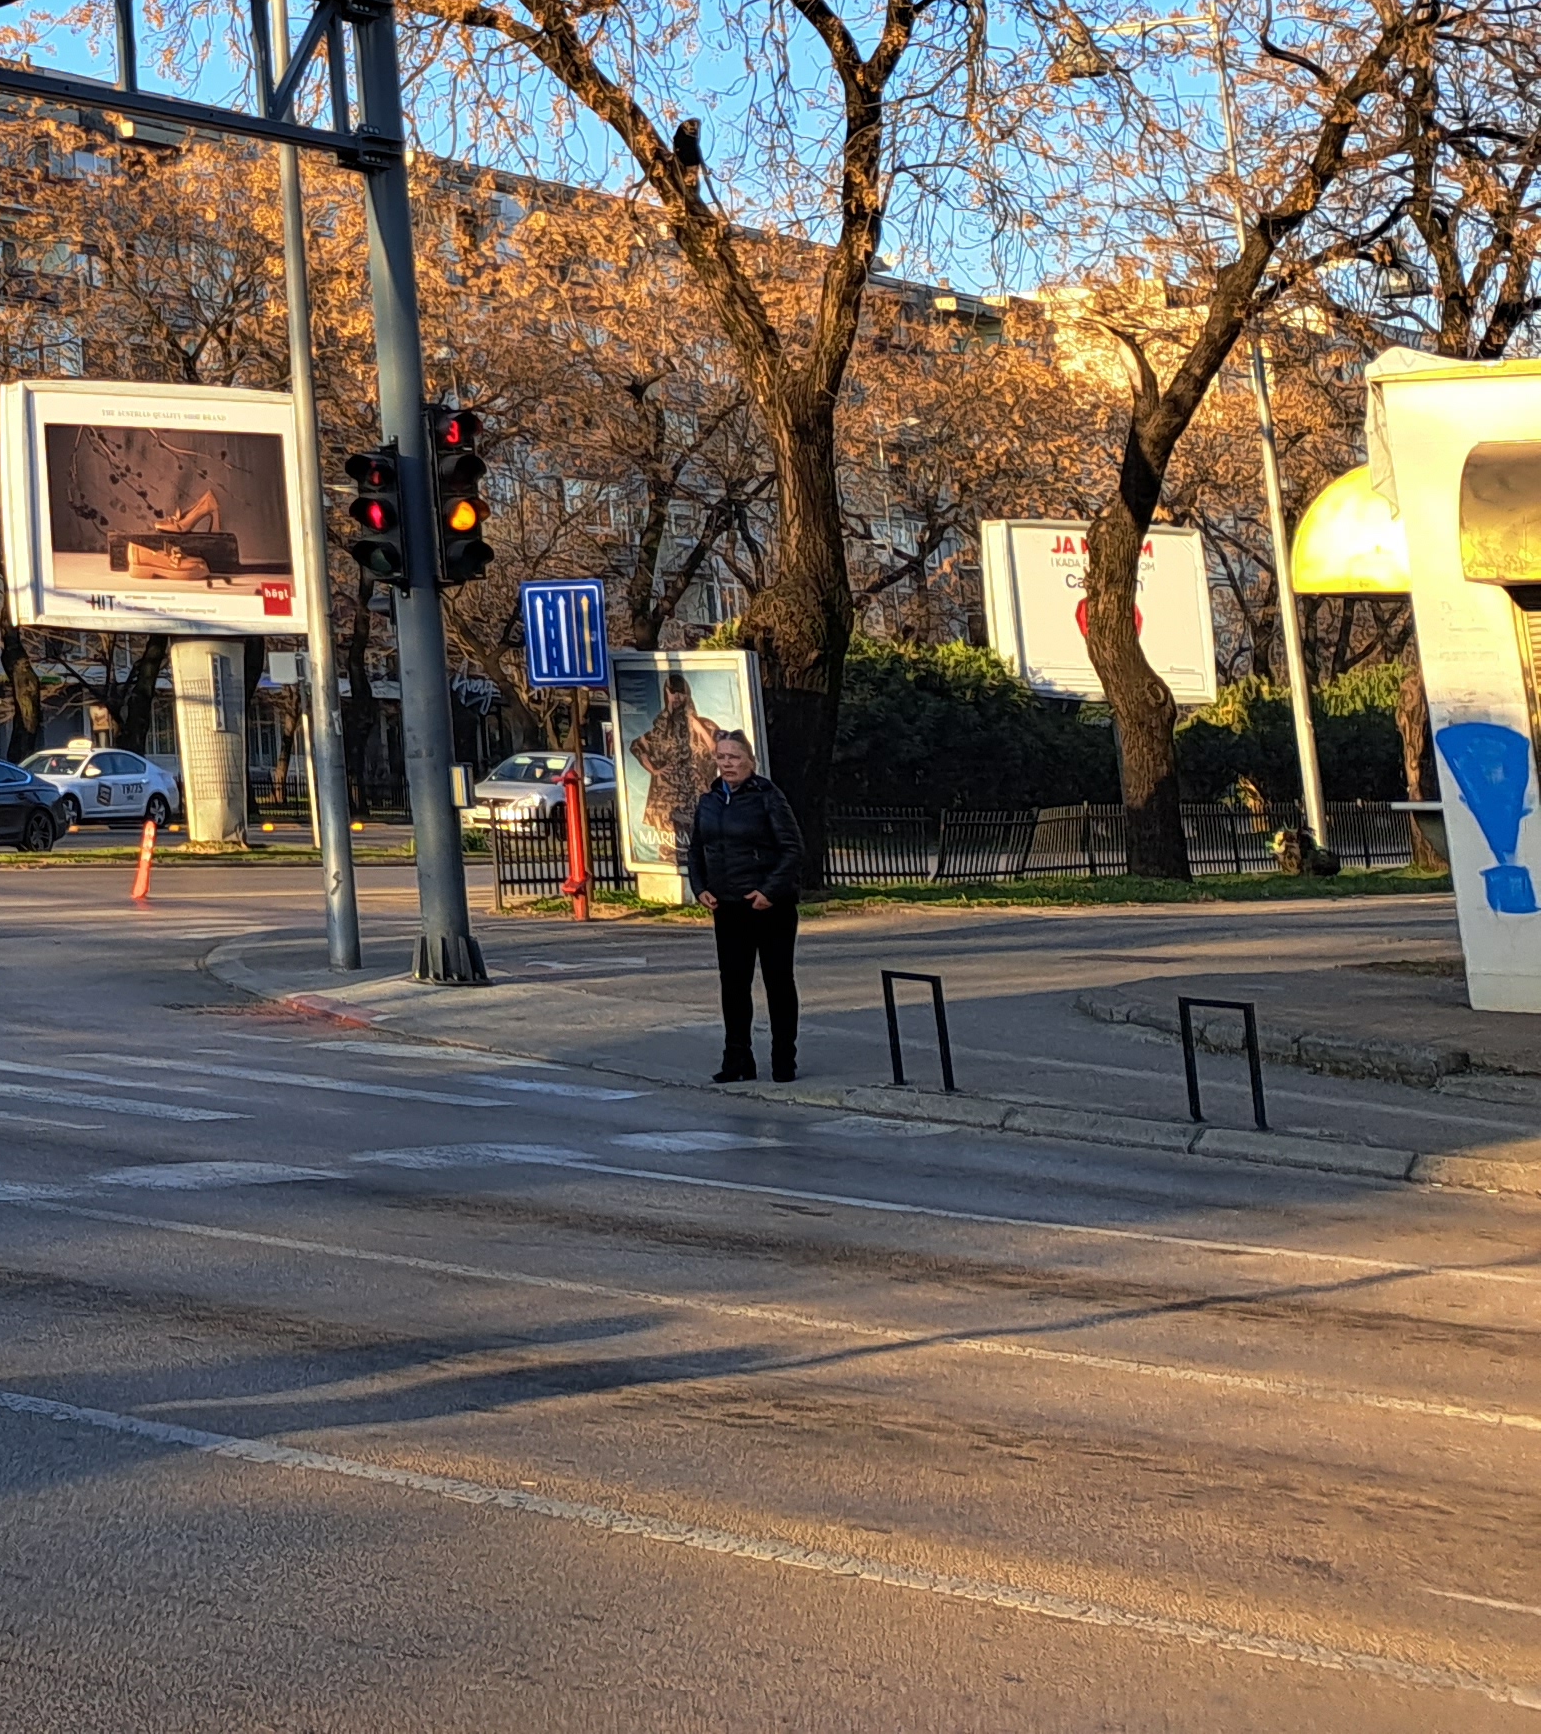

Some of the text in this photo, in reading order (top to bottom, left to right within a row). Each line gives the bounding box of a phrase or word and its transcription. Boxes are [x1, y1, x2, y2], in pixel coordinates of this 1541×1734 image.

[1051, 535, 1076, 554] JA
[1056, 557, 1081, 568] KADA
[264, 588, 289, 600] högl
[90, 593, 116, 611] HIT
